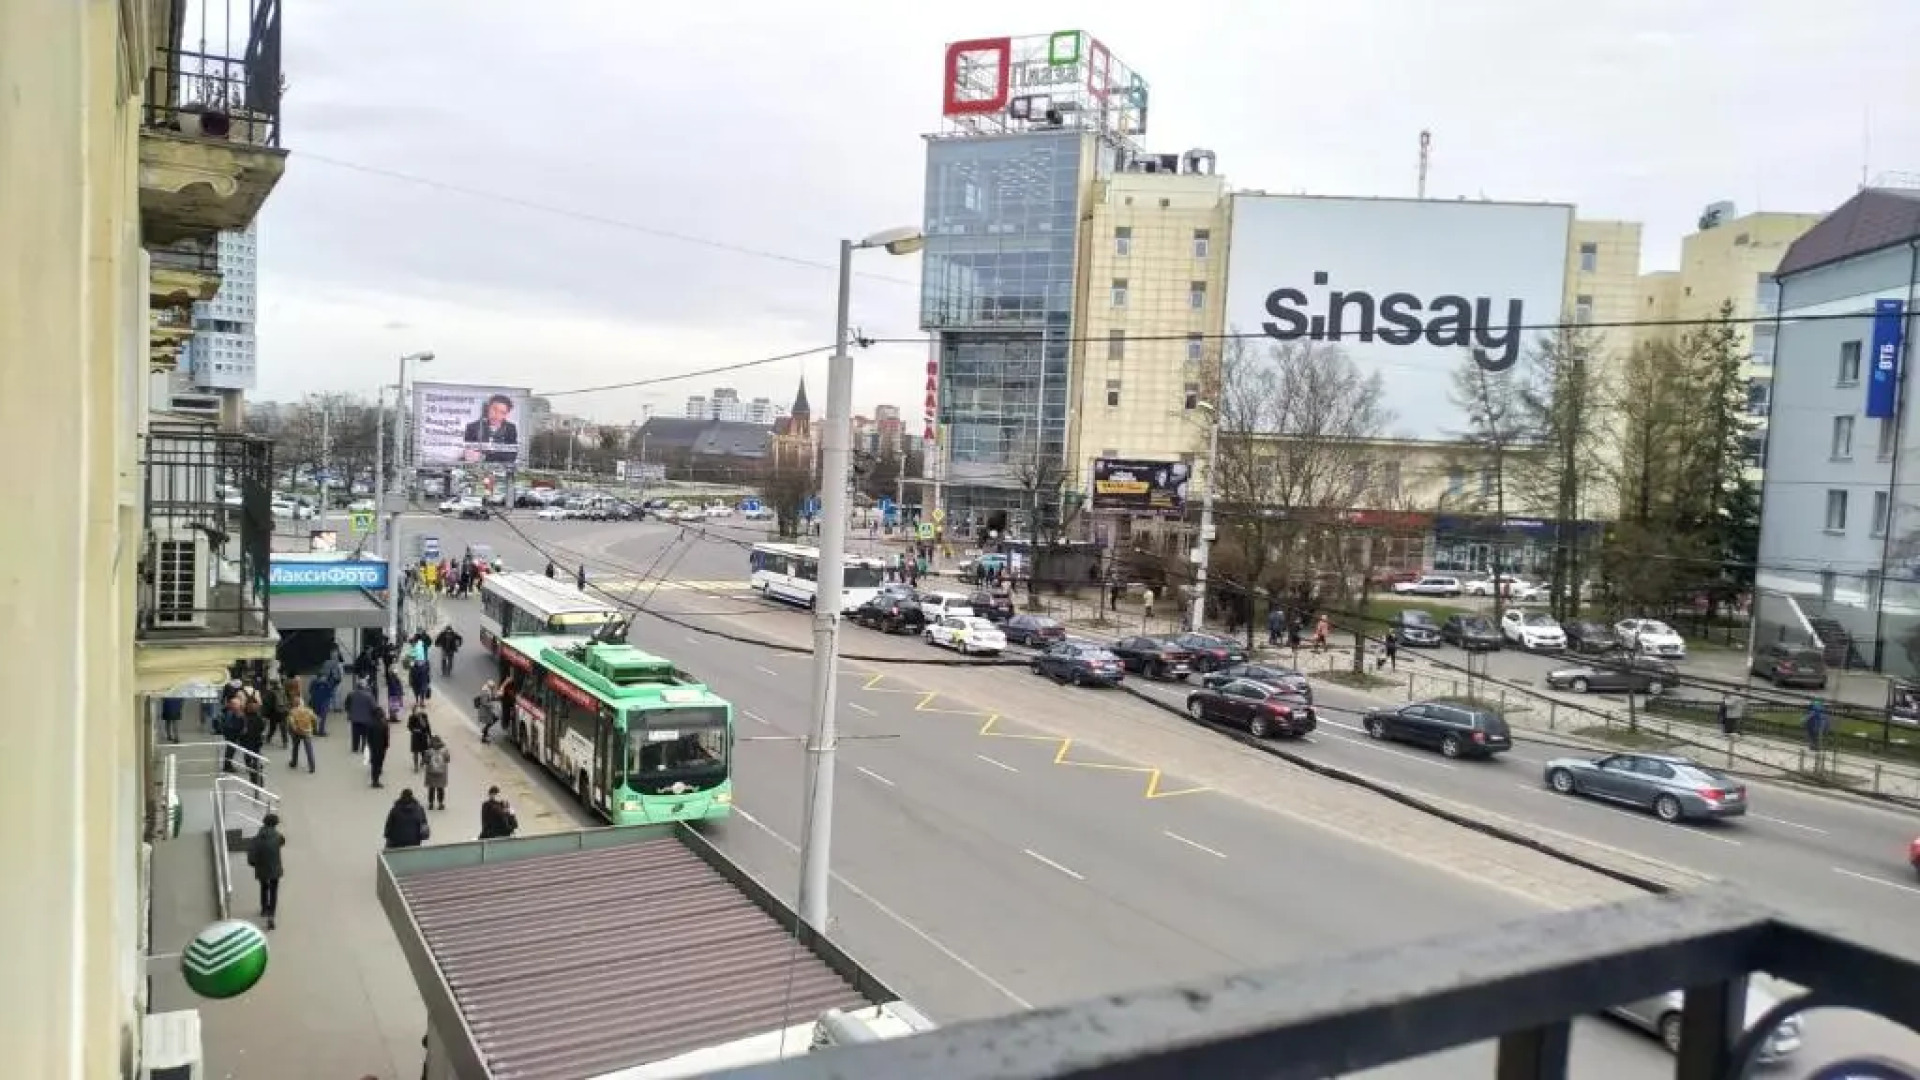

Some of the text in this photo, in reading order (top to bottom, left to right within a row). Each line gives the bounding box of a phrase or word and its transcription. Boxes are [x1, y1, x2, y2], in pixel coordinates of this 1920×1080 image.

[1012, 62, 1080, 88] Плаза
[1262, 271, 1524, 371] sinsay
[1878, 344, 1895, 370] ВТБ
